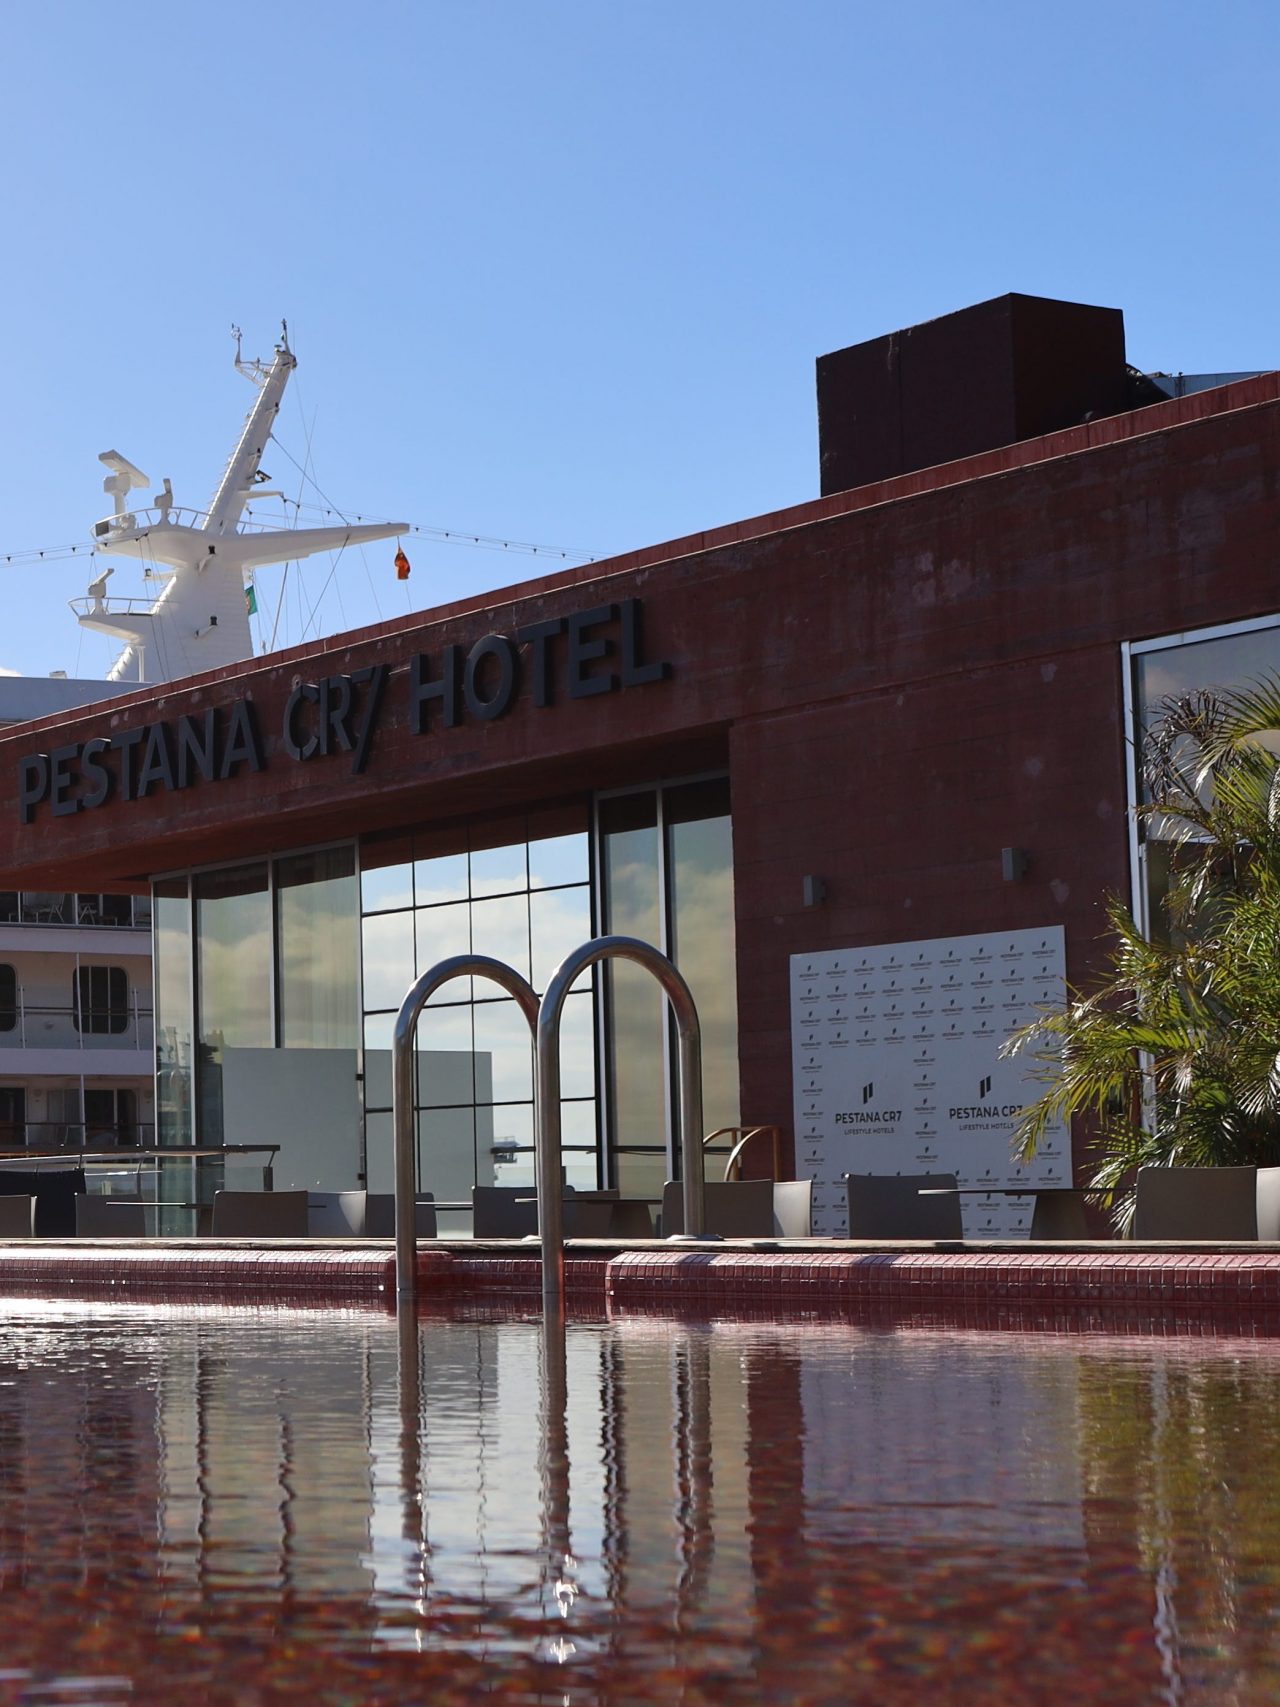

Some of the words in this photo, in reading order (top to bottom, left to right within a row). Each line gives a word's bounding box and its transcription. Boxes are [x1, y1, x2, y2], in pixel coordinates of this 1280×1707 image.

[18, 699, 263, 825] PESTANA
[282, 664, 389, 774] CR7
[410, 598, 668, 736] HOTEL
[835, 1111, 881, 1124] PESTANA
[882, 1110, 902, 1122] CR7
[949, 1106, 1000, 1119] PESTANA
[844, 1128, 872, 1136] LIFESTYLE
[959, 1123, 990, 1131] LIFESTYLE
[991, 1122, 1014, 1130] HOTELS
